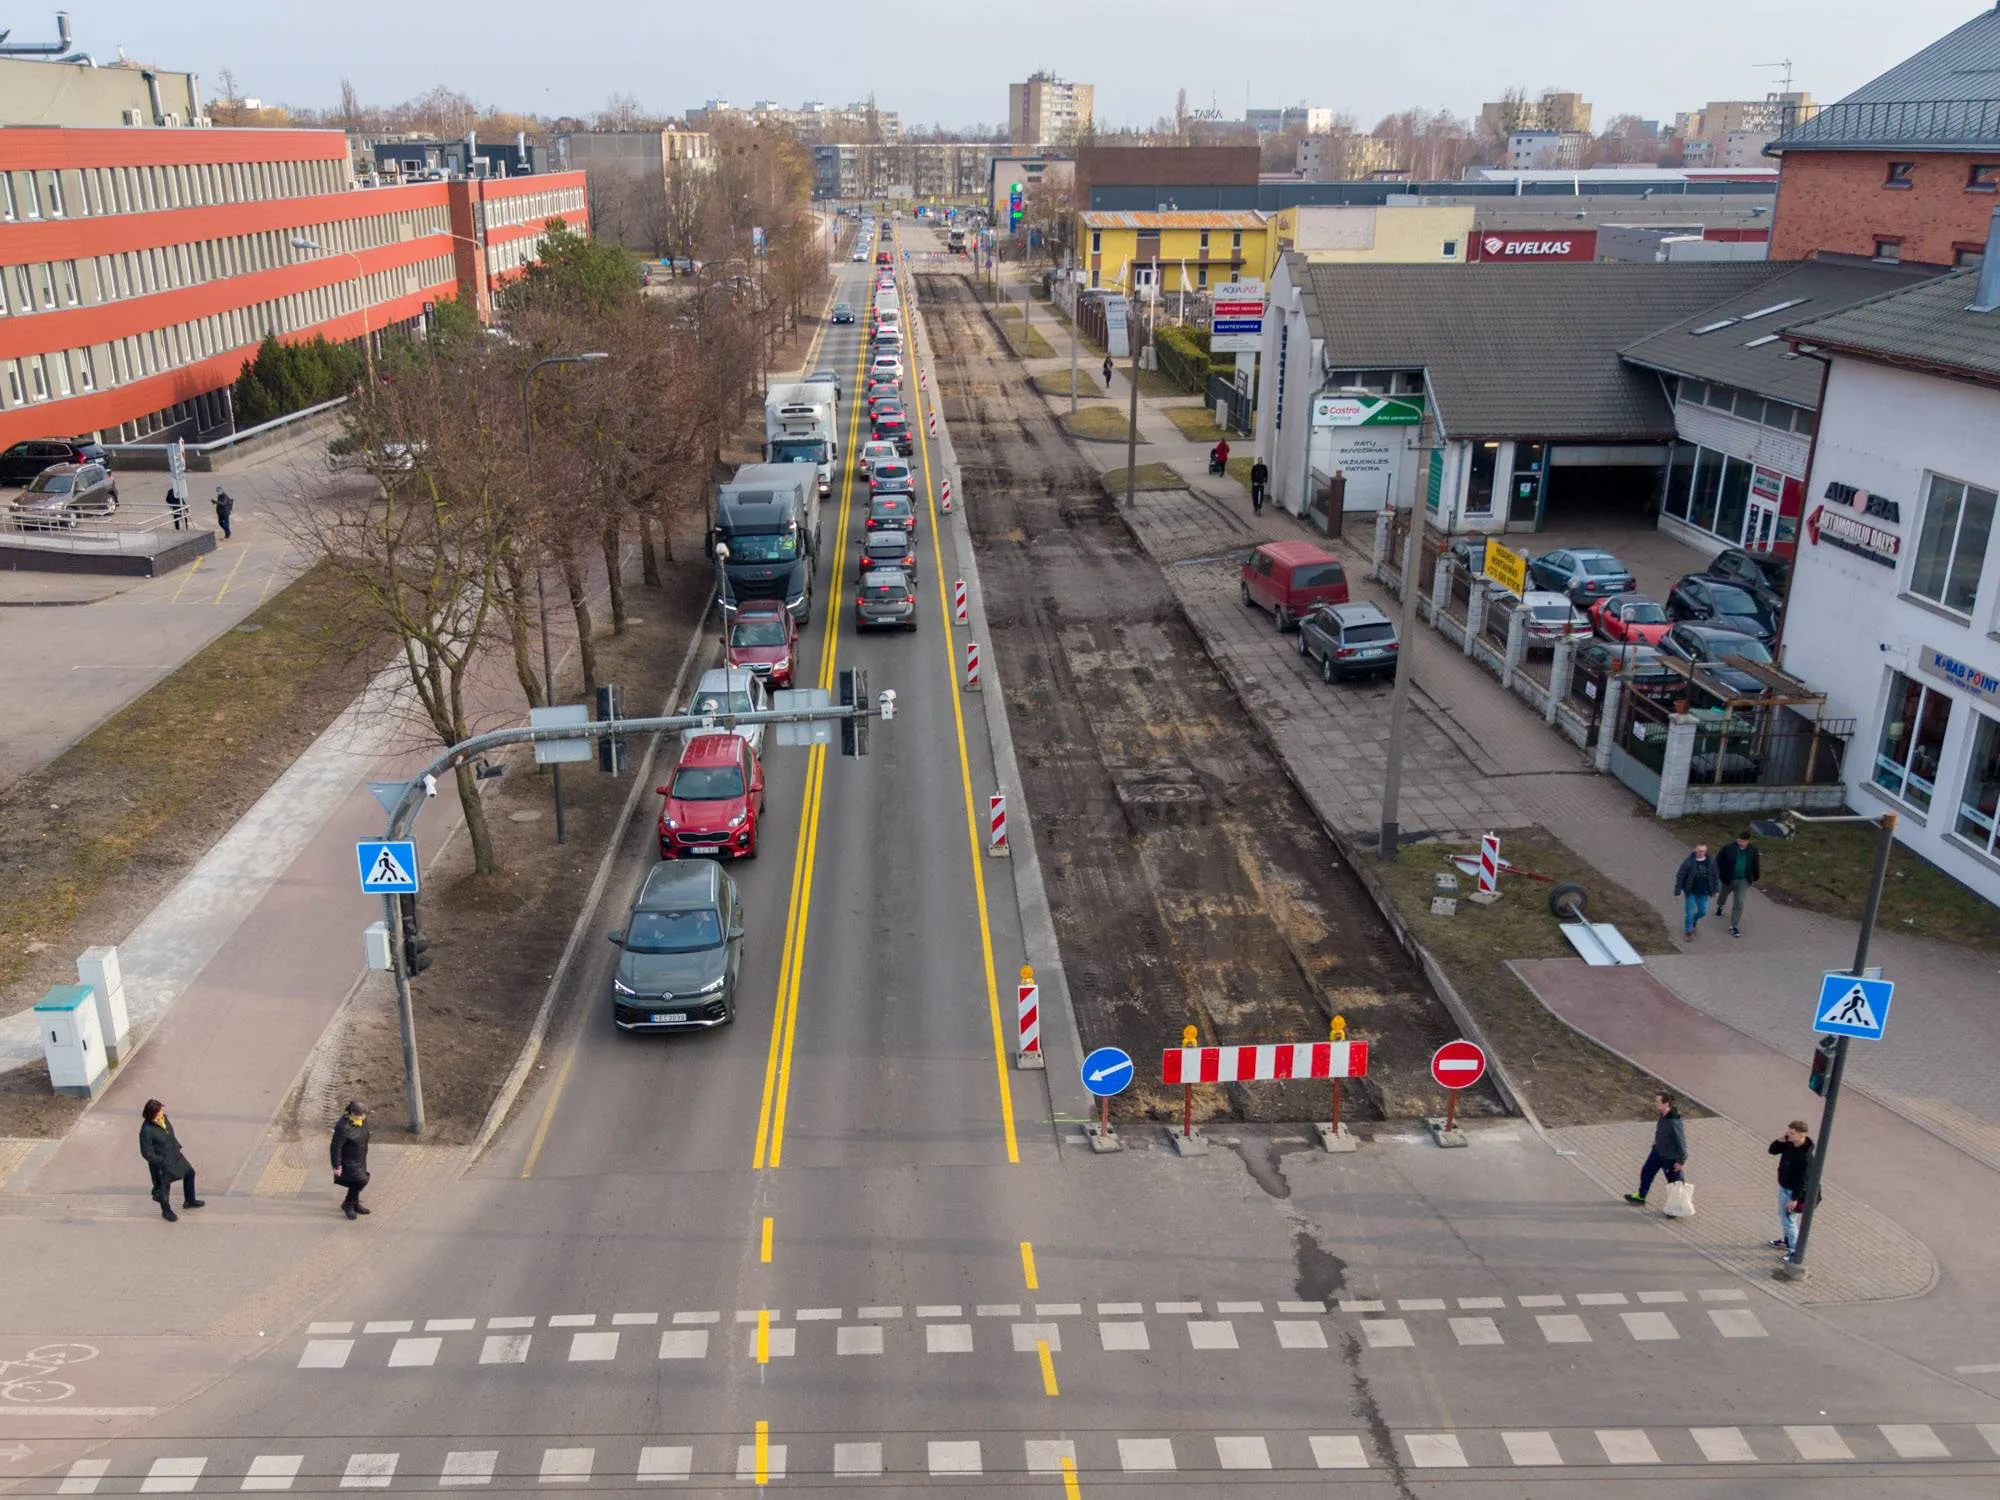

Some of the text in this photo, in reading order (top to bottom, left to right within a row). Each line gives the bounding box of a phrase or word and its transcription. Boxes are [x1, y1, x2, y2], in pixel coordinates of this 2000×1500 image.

[1504, 241, 1572, 255] EVELKAS
[1329, 407, 1360, 415] Castrol
[1870, 528, 1897, 554] DALYS
[1966, 667, 1999, 694] POINT
